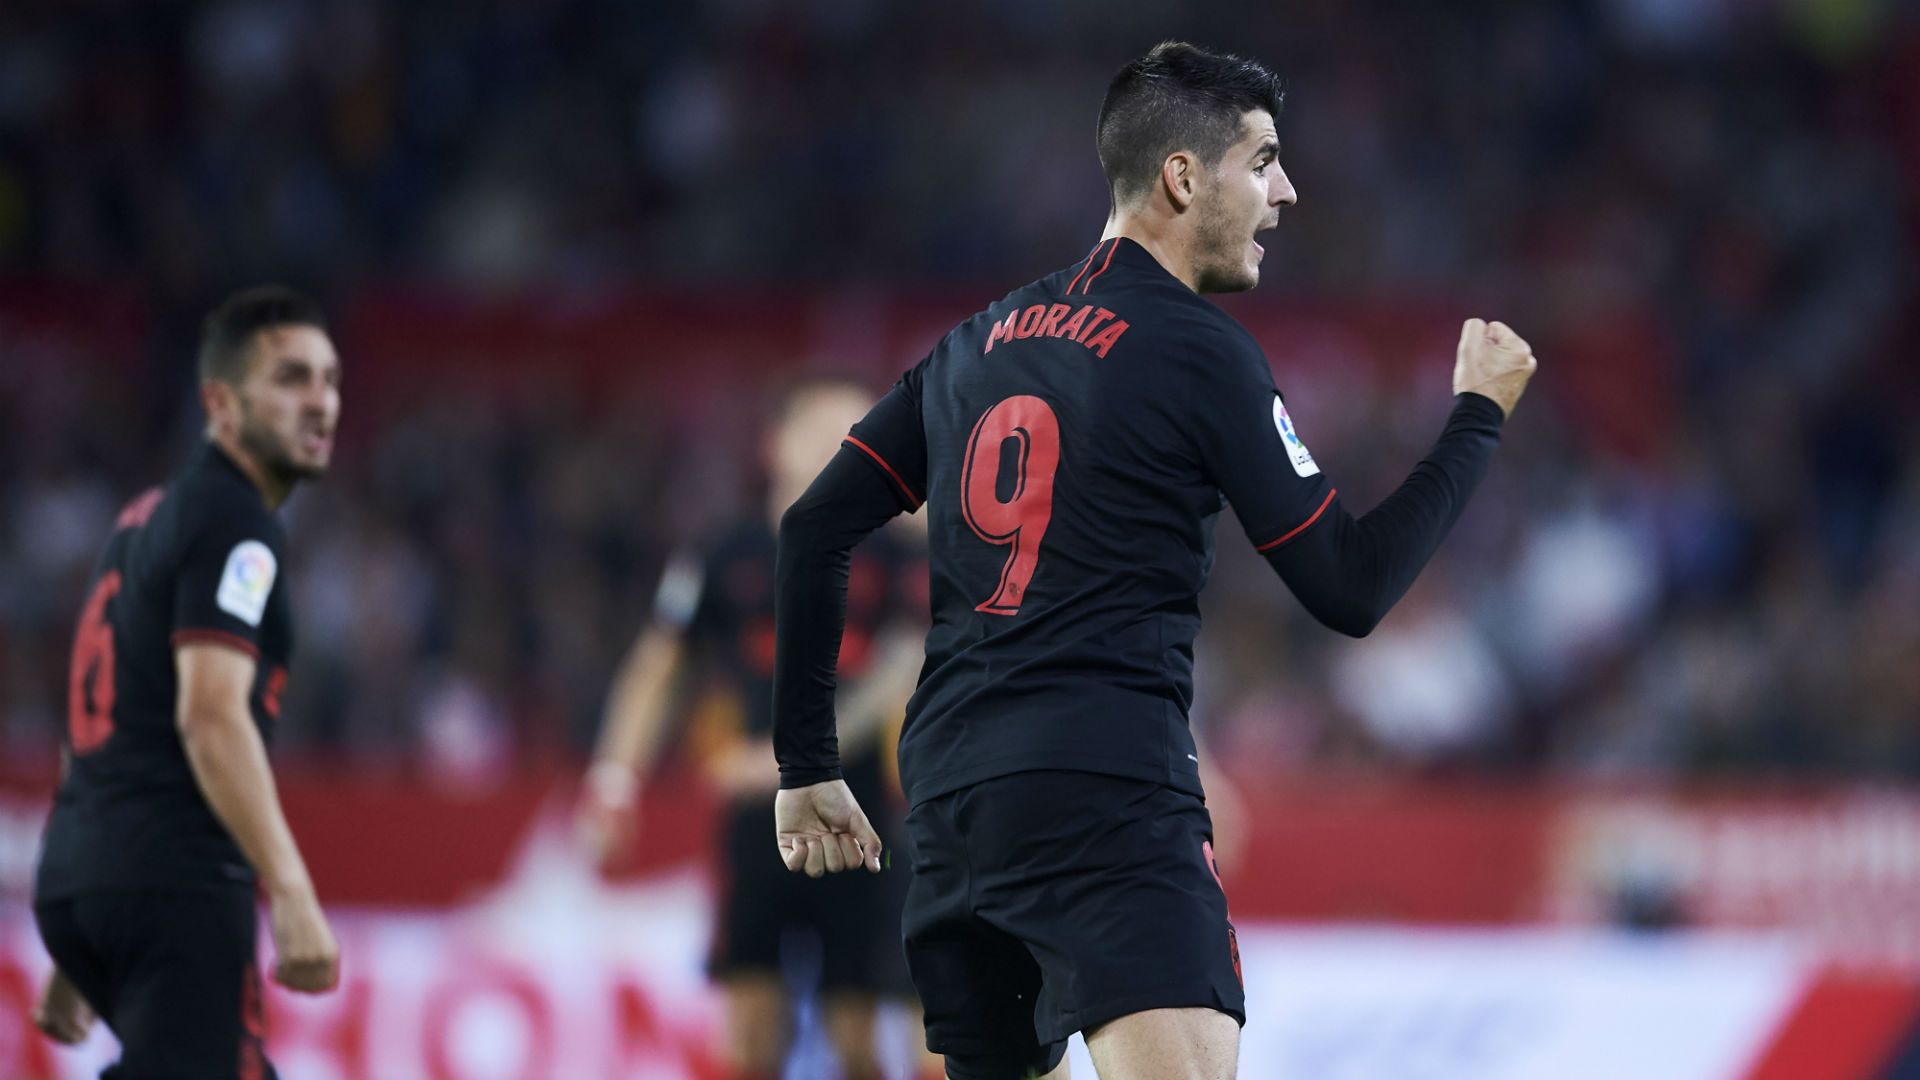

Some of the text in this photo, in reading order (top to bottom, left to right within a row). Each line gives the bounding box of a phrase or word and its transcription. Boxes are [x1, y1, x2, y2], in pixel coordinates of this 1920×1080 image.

[985, 303, 1130, 358] MORATA
[961, 395, 1060, 616] 9
[69, 569, 121, 755] 6
